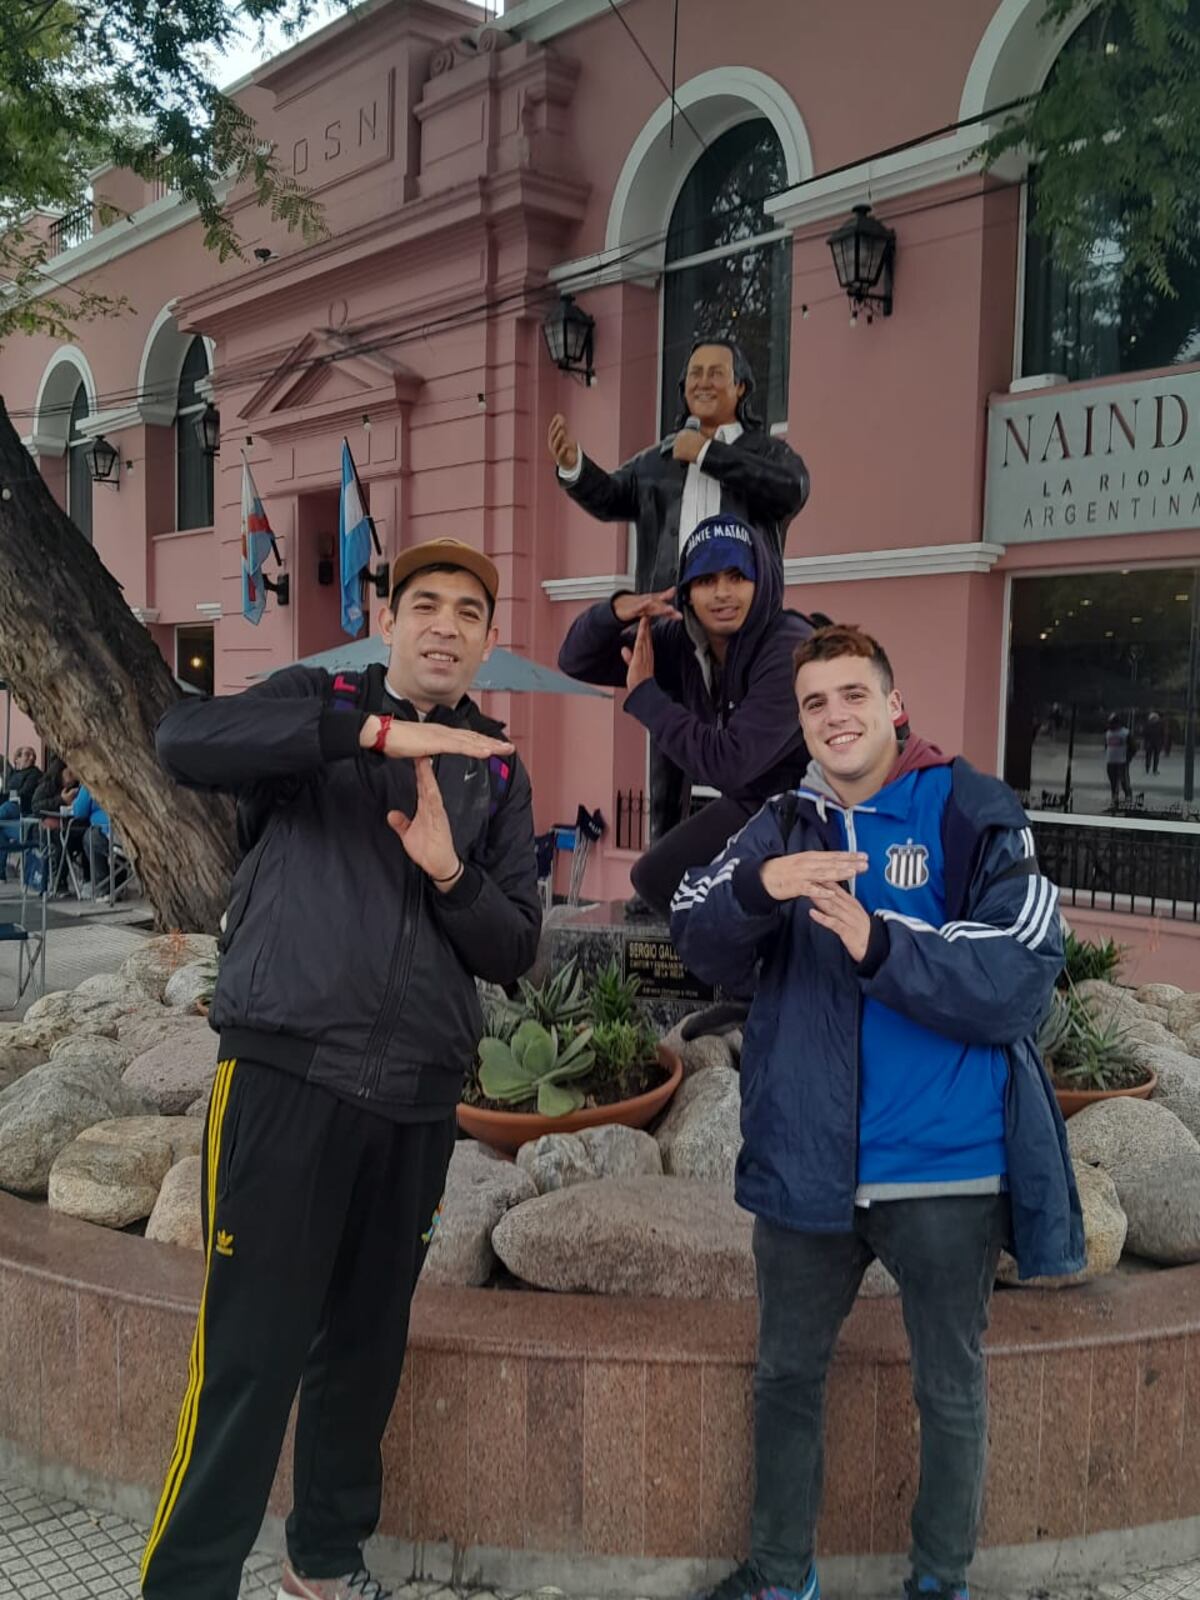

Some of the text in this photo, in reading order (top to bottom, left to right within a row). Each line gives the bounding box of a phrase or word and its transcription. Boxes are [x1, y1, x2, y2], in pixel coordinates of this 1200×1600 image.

[1043, 464, 1195, 498] LA RIOJA
[629, 942, 657, 959] SERGIO
